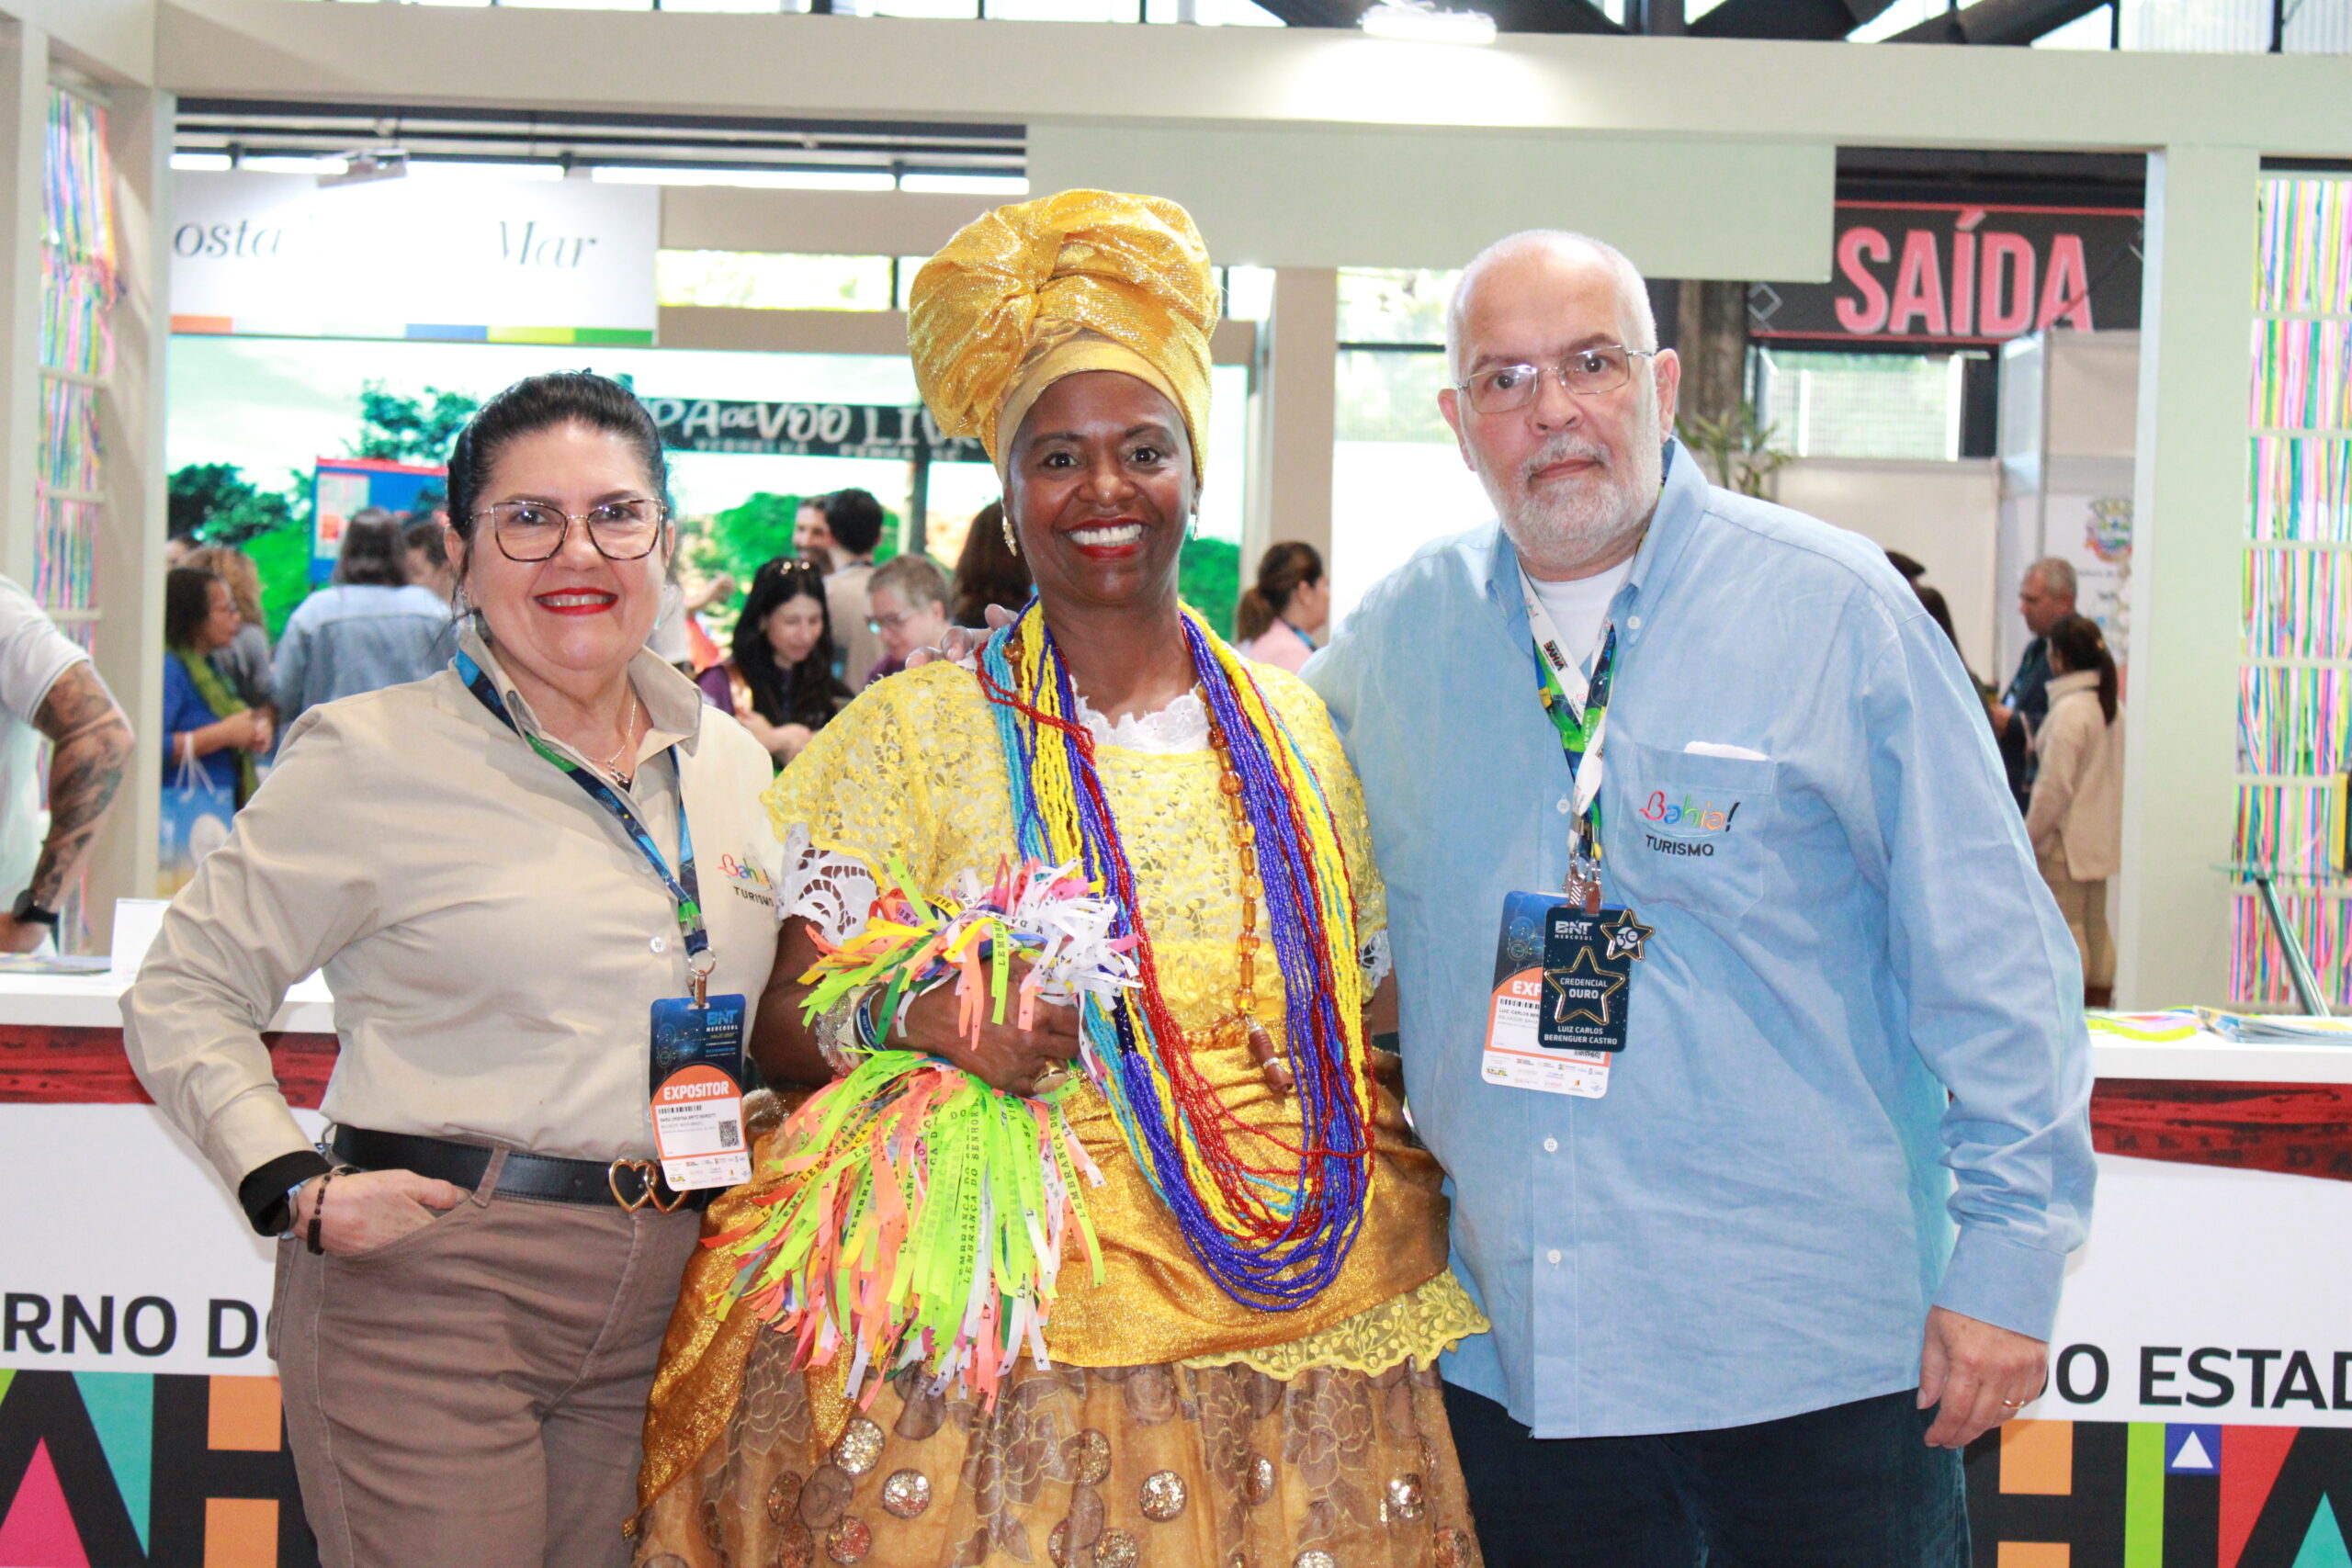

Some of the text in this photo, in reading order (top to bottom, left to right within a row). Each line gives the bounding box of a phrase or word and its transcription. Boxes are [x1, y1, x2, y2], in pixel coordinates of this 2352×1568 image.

[1834, 207, 2095, 336] SAÍDA
[1645, 834, 1714, 856] TURISMO
[1555, 919, 1593, 935] BNT
[1560, 977, 1608, 987] CREDENCIAL
[1568, 987, 1600, 999] OURO
[1544, 1033, 1618, 1045] BERENGUER CASTRO
[1557, 1025, 1603, 1035] LUIZ CARLOS
[663, 1080, 729, 1101] EXPOSITOR
[3, 1292, 272, 1359] RNO D
[2039, 1343, 2109, 1404] O
